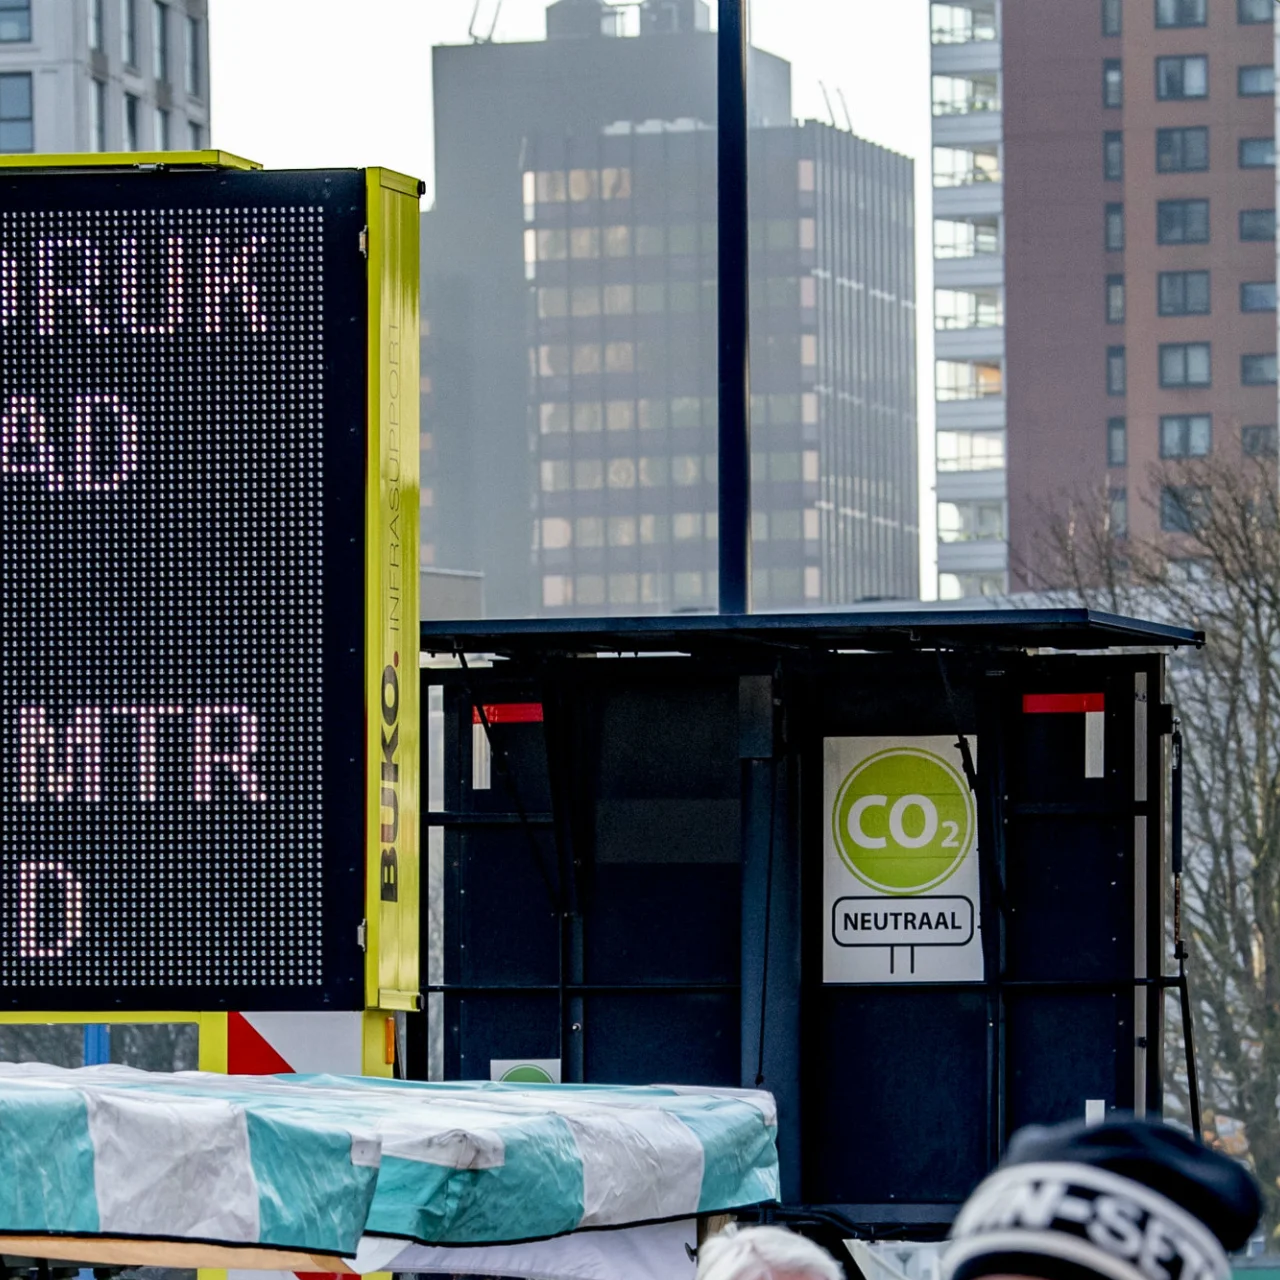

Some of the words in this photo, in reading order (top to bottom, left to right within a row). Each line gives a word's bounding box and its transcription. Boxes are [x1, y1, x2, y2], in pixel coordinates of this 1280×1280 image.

[387, 321, 400, 632] INFRASUPPORT
[16, 701, 270, 804] MTR
[843, 911, 962, 931] NEUTRAAL
